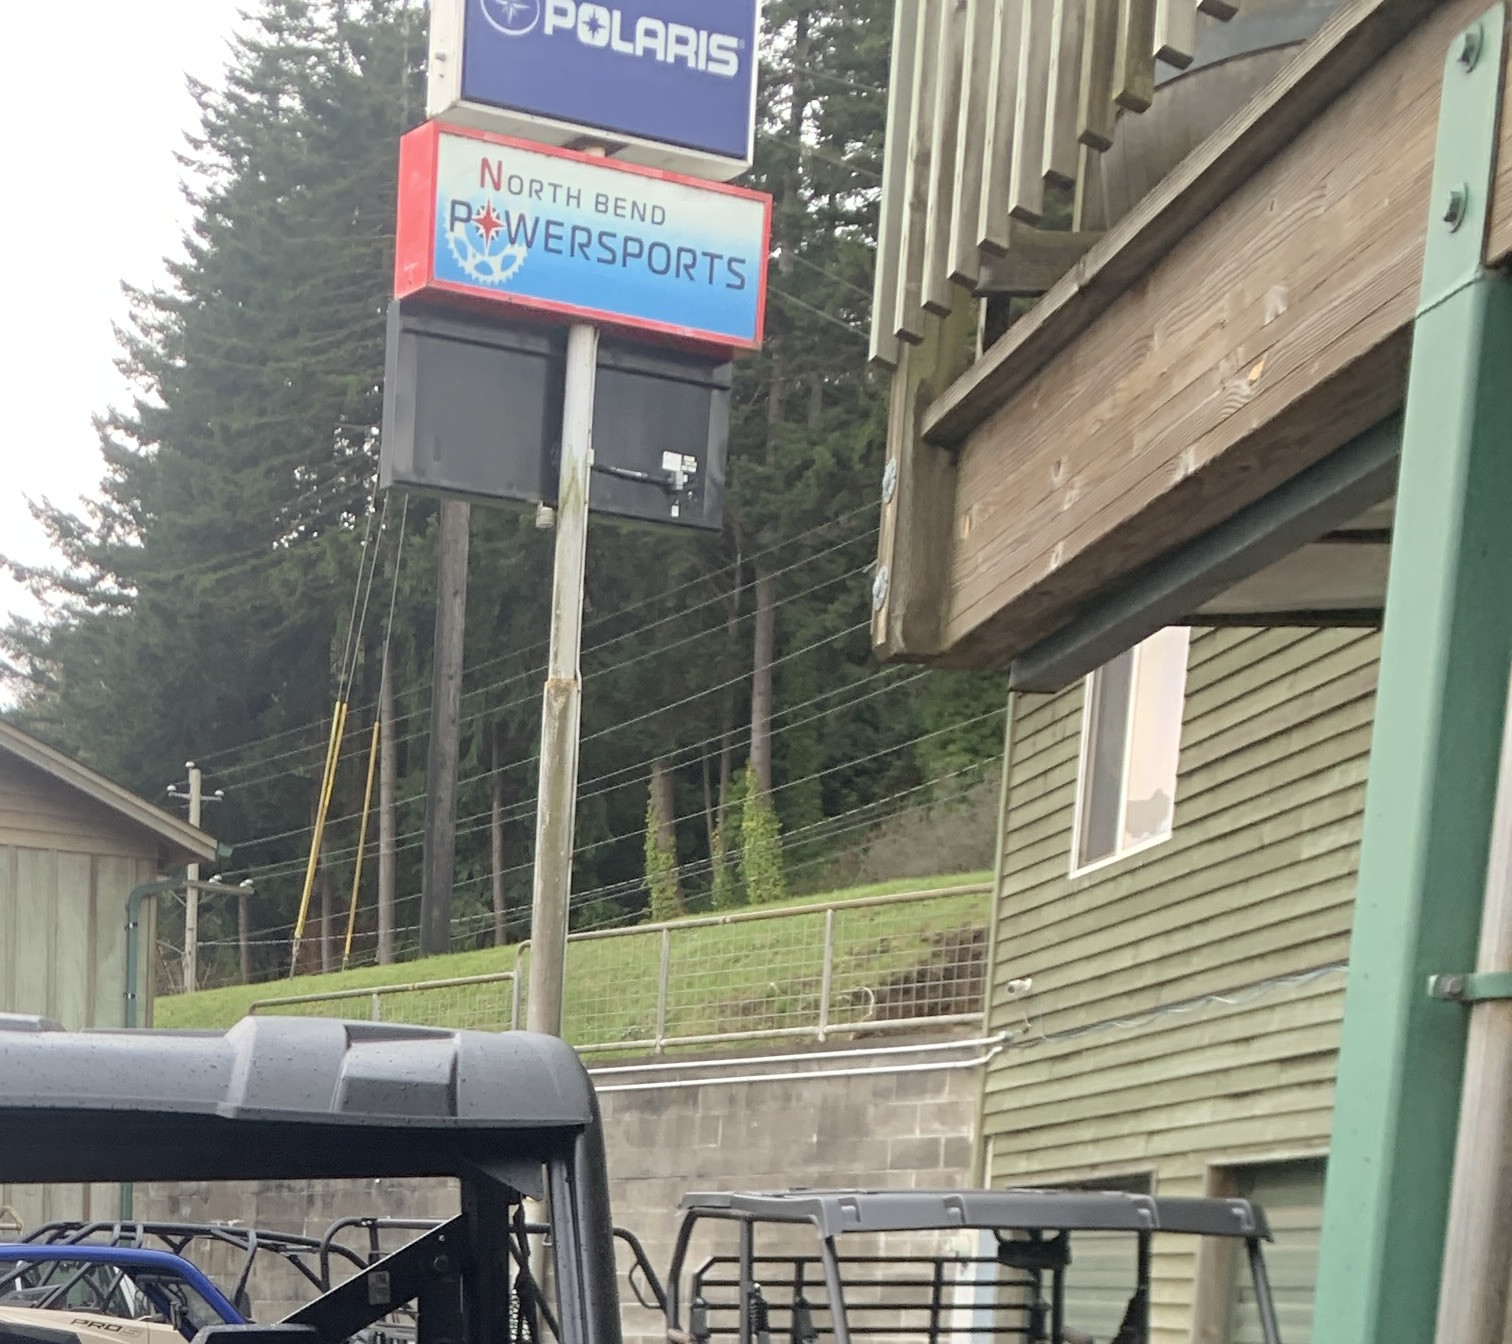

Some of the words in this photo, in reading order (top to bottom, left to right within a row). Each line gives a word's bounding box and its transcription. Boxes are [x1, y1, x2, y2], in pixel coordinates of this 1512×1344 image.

[544, 0, 739, 77] POLARIS
[480, 157, 582, 209] NORTH
[594, 192, 666, 226] BEND
[449, 198, 747, 290] POWERSPORTS
[69, 1318, 123, 1332] PRO
